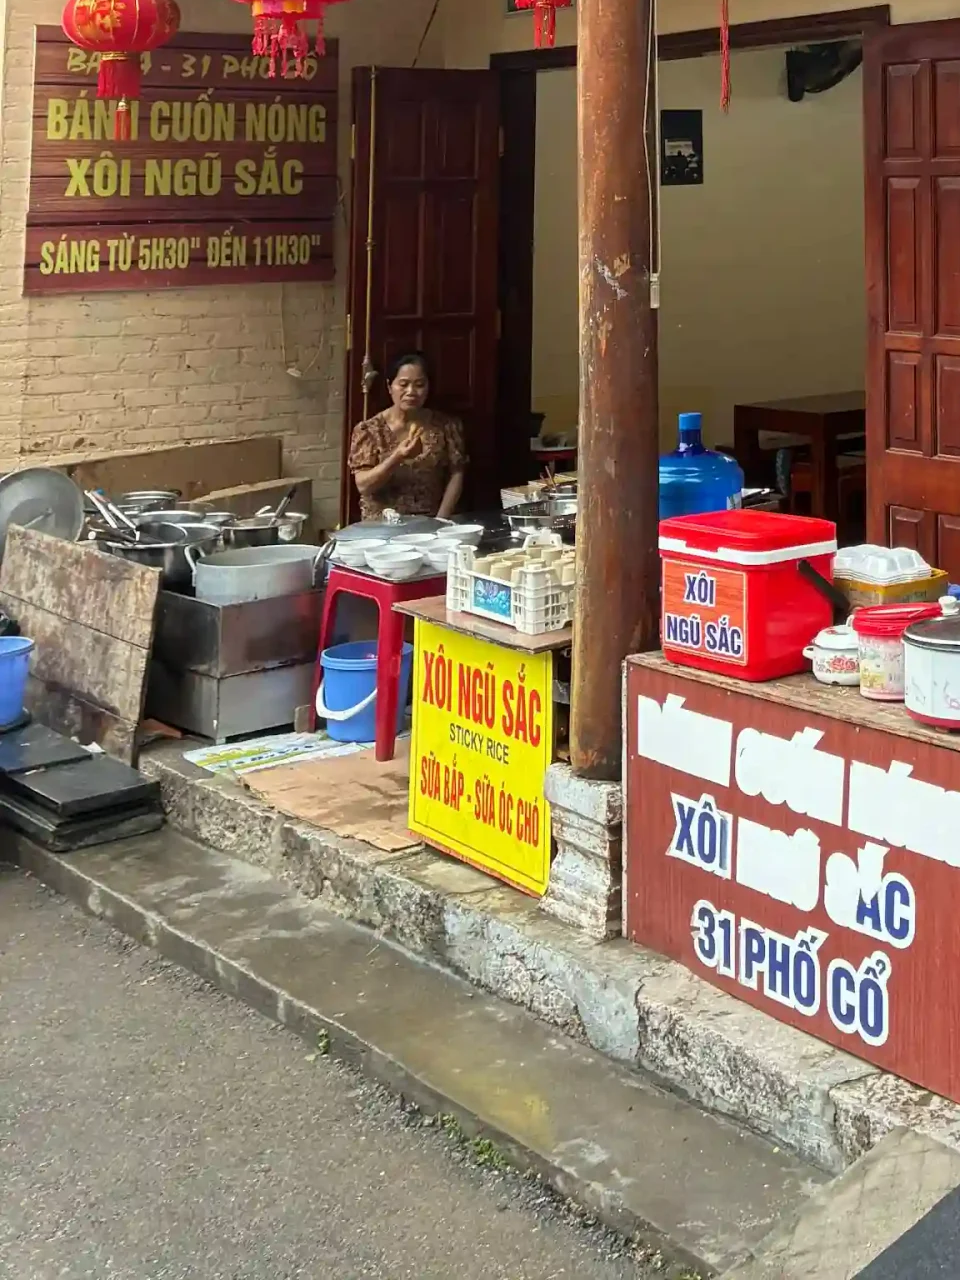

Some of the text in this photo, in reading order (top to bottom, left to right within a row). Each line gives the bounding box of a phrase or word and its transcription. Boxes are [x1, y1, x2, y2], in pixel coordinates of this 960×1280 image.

[182, 54, 210, 78] 31
[150, 88, 235, 142] CUỐN
[245, 95, 326, 143] NÓNG
[64, 146, 304, 198] XÔI NGŨ SẮC
[39, 234, 100, 276] SÁNG
[107, 232, 135, 272] TỪ
[207, 226, 247, 268] ĐẾN
[685, 573, 714, 605] XÔI
[667, 616, 741, 655] NGŨ SẮC
[422, 644, 542, 747] XÔI NGŨ SẮC
[449, 722, 510, 765] STICKY RICE
[420, 751, 441, 801] SỮA
[443, 753, 464, 812] BẮP
[474, 775, 495, 826] SỮA
[499, 782, 513, 835] ÓC
[516, 795, 539, 848] CHÓ
[675, 801, 728, 871] XÔI
[698, 907, 884, 1038] 31 PHỐ CỔ
